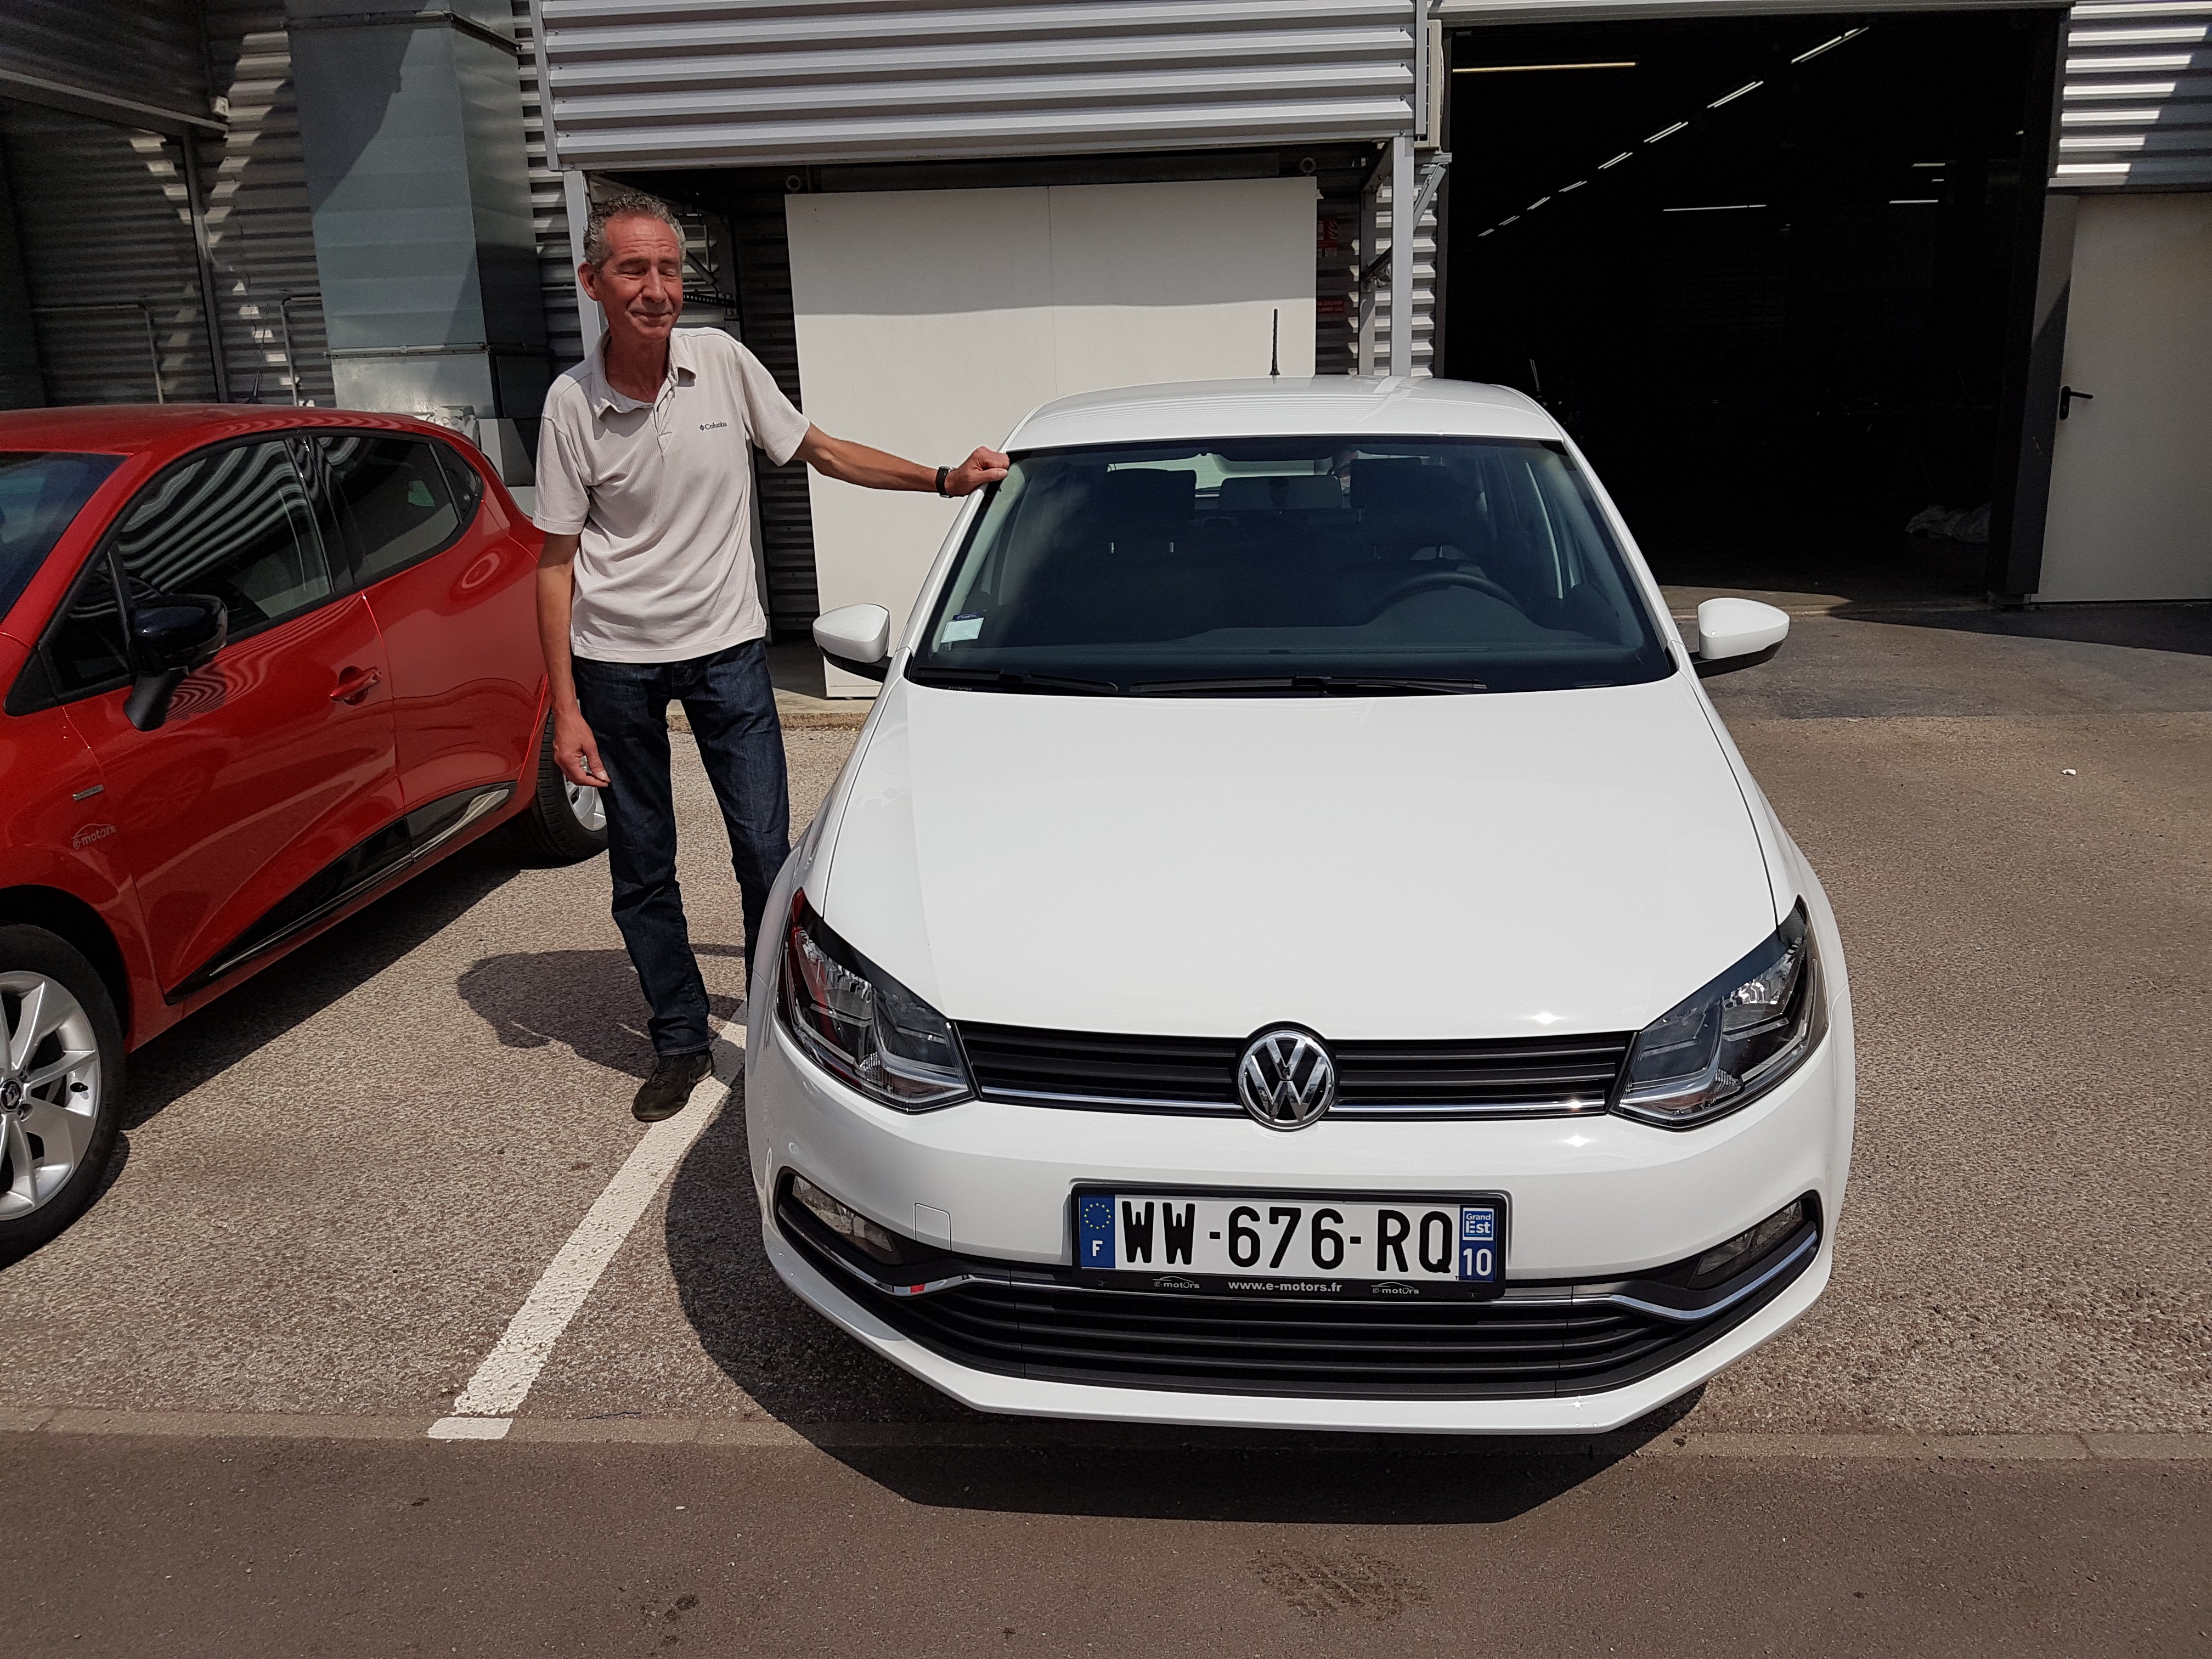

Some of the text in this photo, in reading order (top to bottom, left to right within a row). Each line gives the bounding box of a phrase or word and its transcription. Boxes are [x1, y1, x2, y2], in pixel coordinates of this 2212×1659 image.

[1465, 1221, 1491, 1234] Est
[1122, 1201, 1453, 1273] WW-676-RQ
[1092, 1240, 1103, 1256] F
[1463, 1248, 1492, 1276] 10
[1228, 1282, 1342, 1292] www.e-motors.fr
